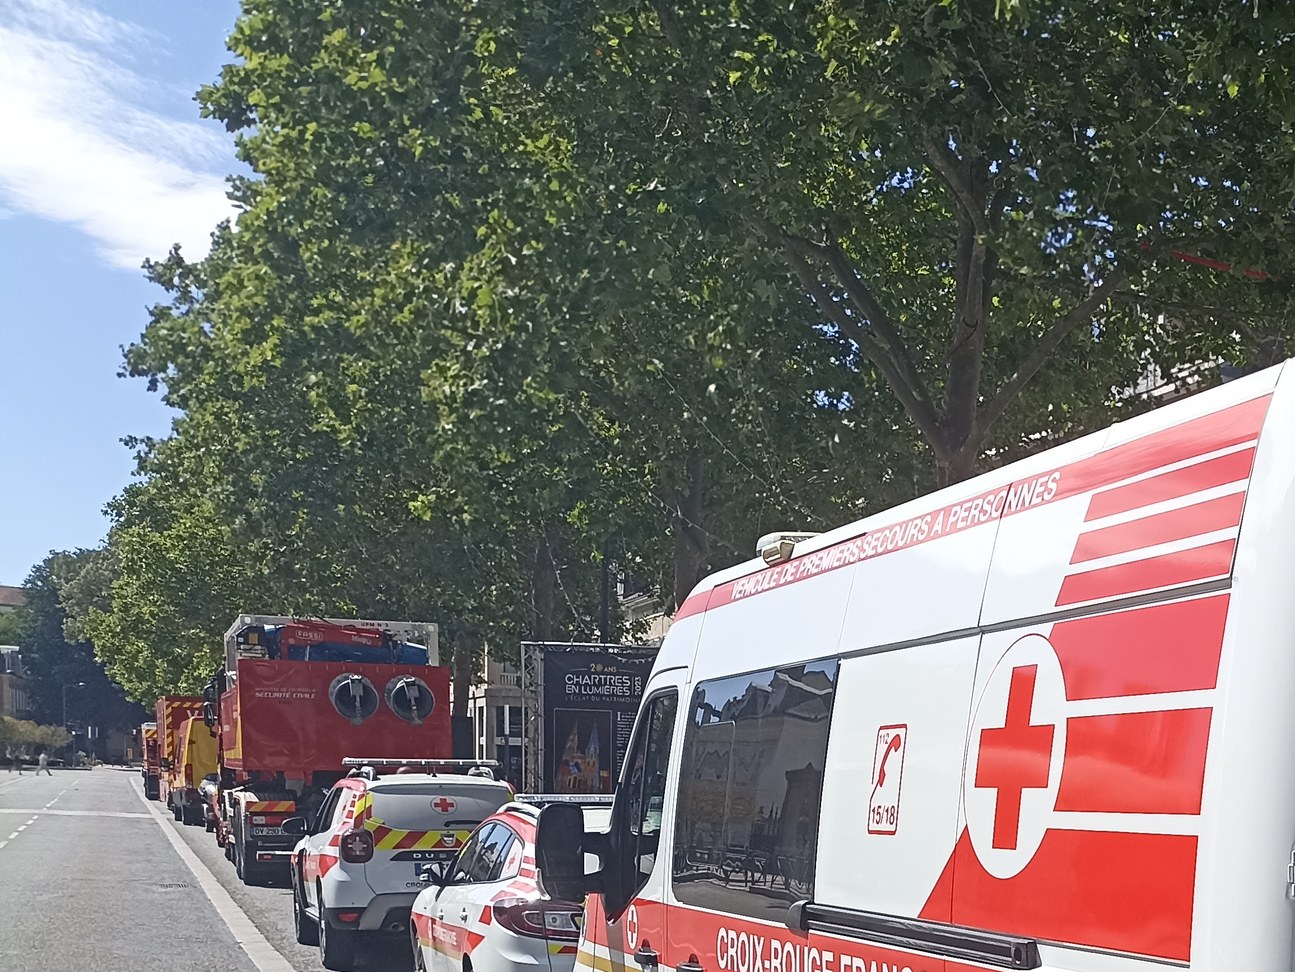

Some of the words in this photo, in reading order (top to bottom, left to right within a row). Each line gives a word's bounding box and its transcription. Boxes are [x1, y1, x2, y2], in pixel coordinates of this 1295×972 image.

[731, 567, 778, 600] VEHICULE
[779, 561, 799, 584] DE
[796, 539, 862, 577] PREMIERS
[860, 516, 931, 559] SECOURS
[930, 511, 945, 537] A
[946, 471, 1061, 531] PERSONNES
[565, 673, 631, 687] CHARTRES
[565, 684, 579, 693] EN
[871, 804, 896, 825] 15/18
